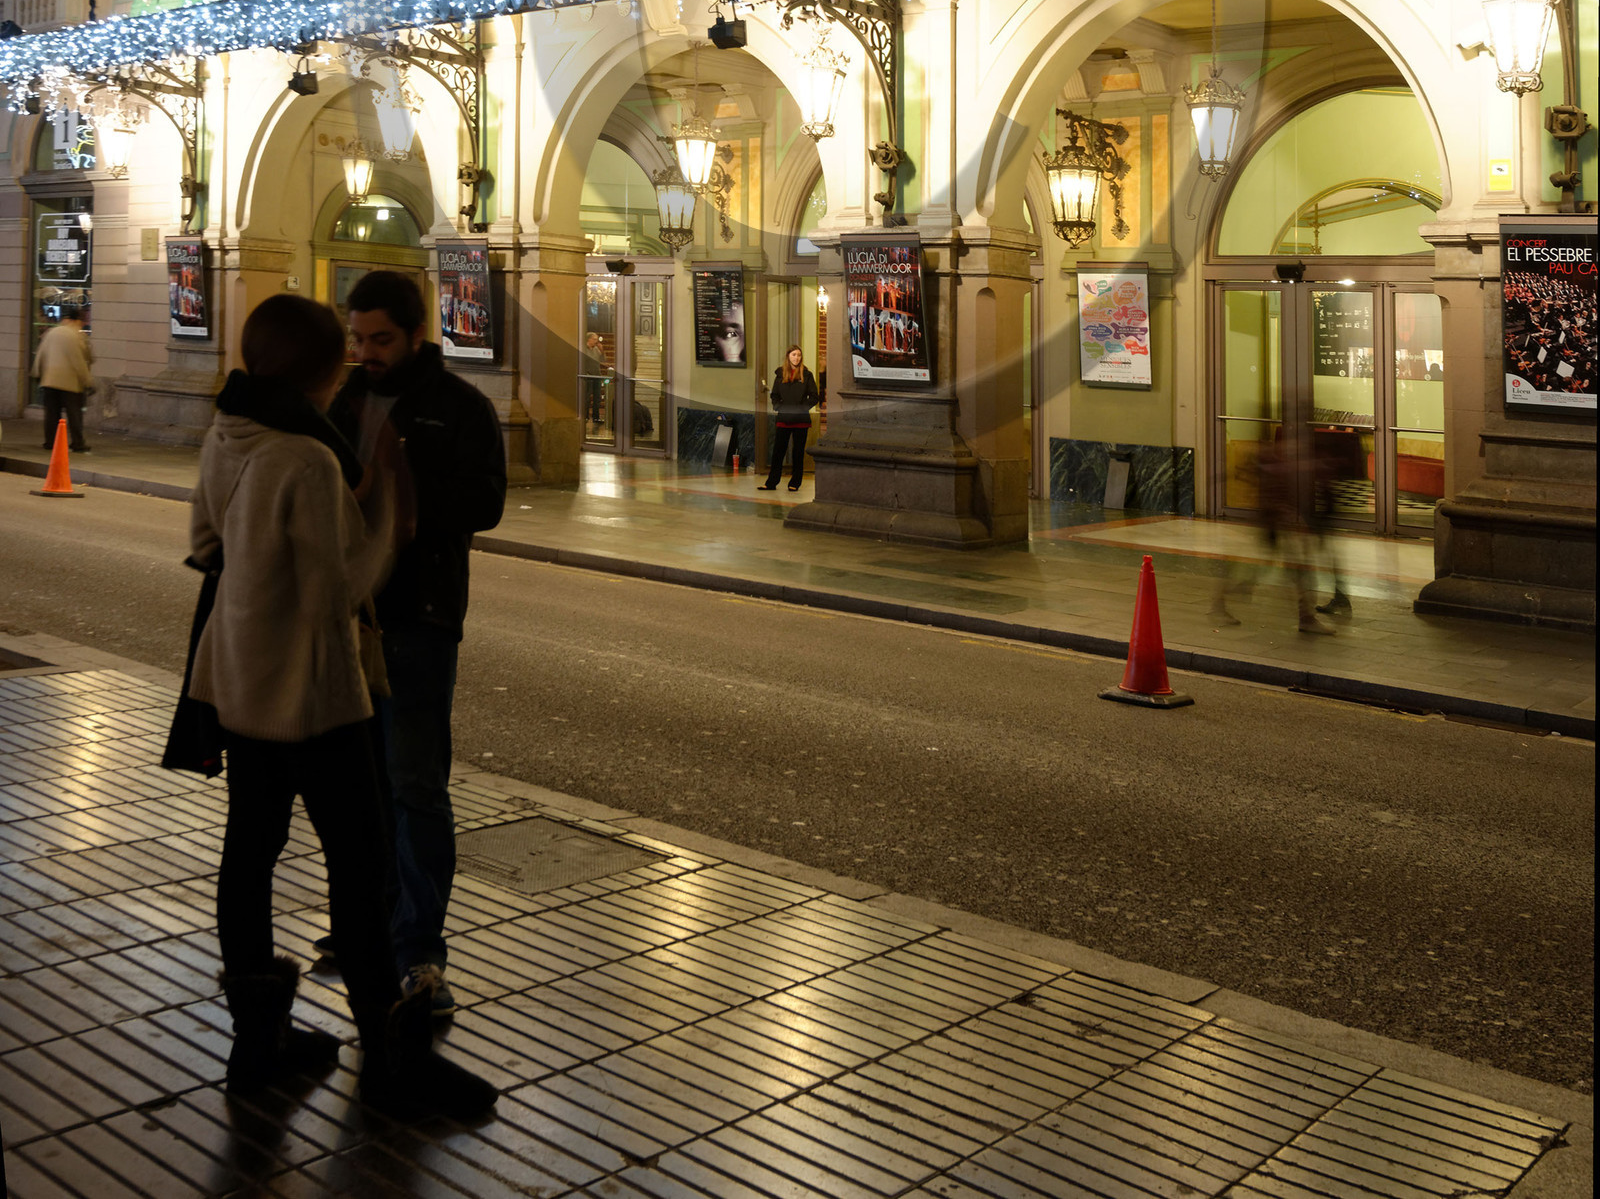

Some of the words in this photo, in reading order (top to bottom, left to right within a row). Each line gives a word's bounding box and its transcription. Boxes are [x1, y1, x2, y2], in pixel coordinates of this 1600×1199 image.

[1506, 239, 1547, 247] CONCERT
[847, 252, 876, 264] LUCIA
[879, 254, 887, 264] DI
[1507, 247, 1521, 261] EL
[1525, 247, 1592, 262] PESSEBRE
[849, 263, 912, 274] LAMMERMOOR
[1549, 262, 1573, 274] PAU
